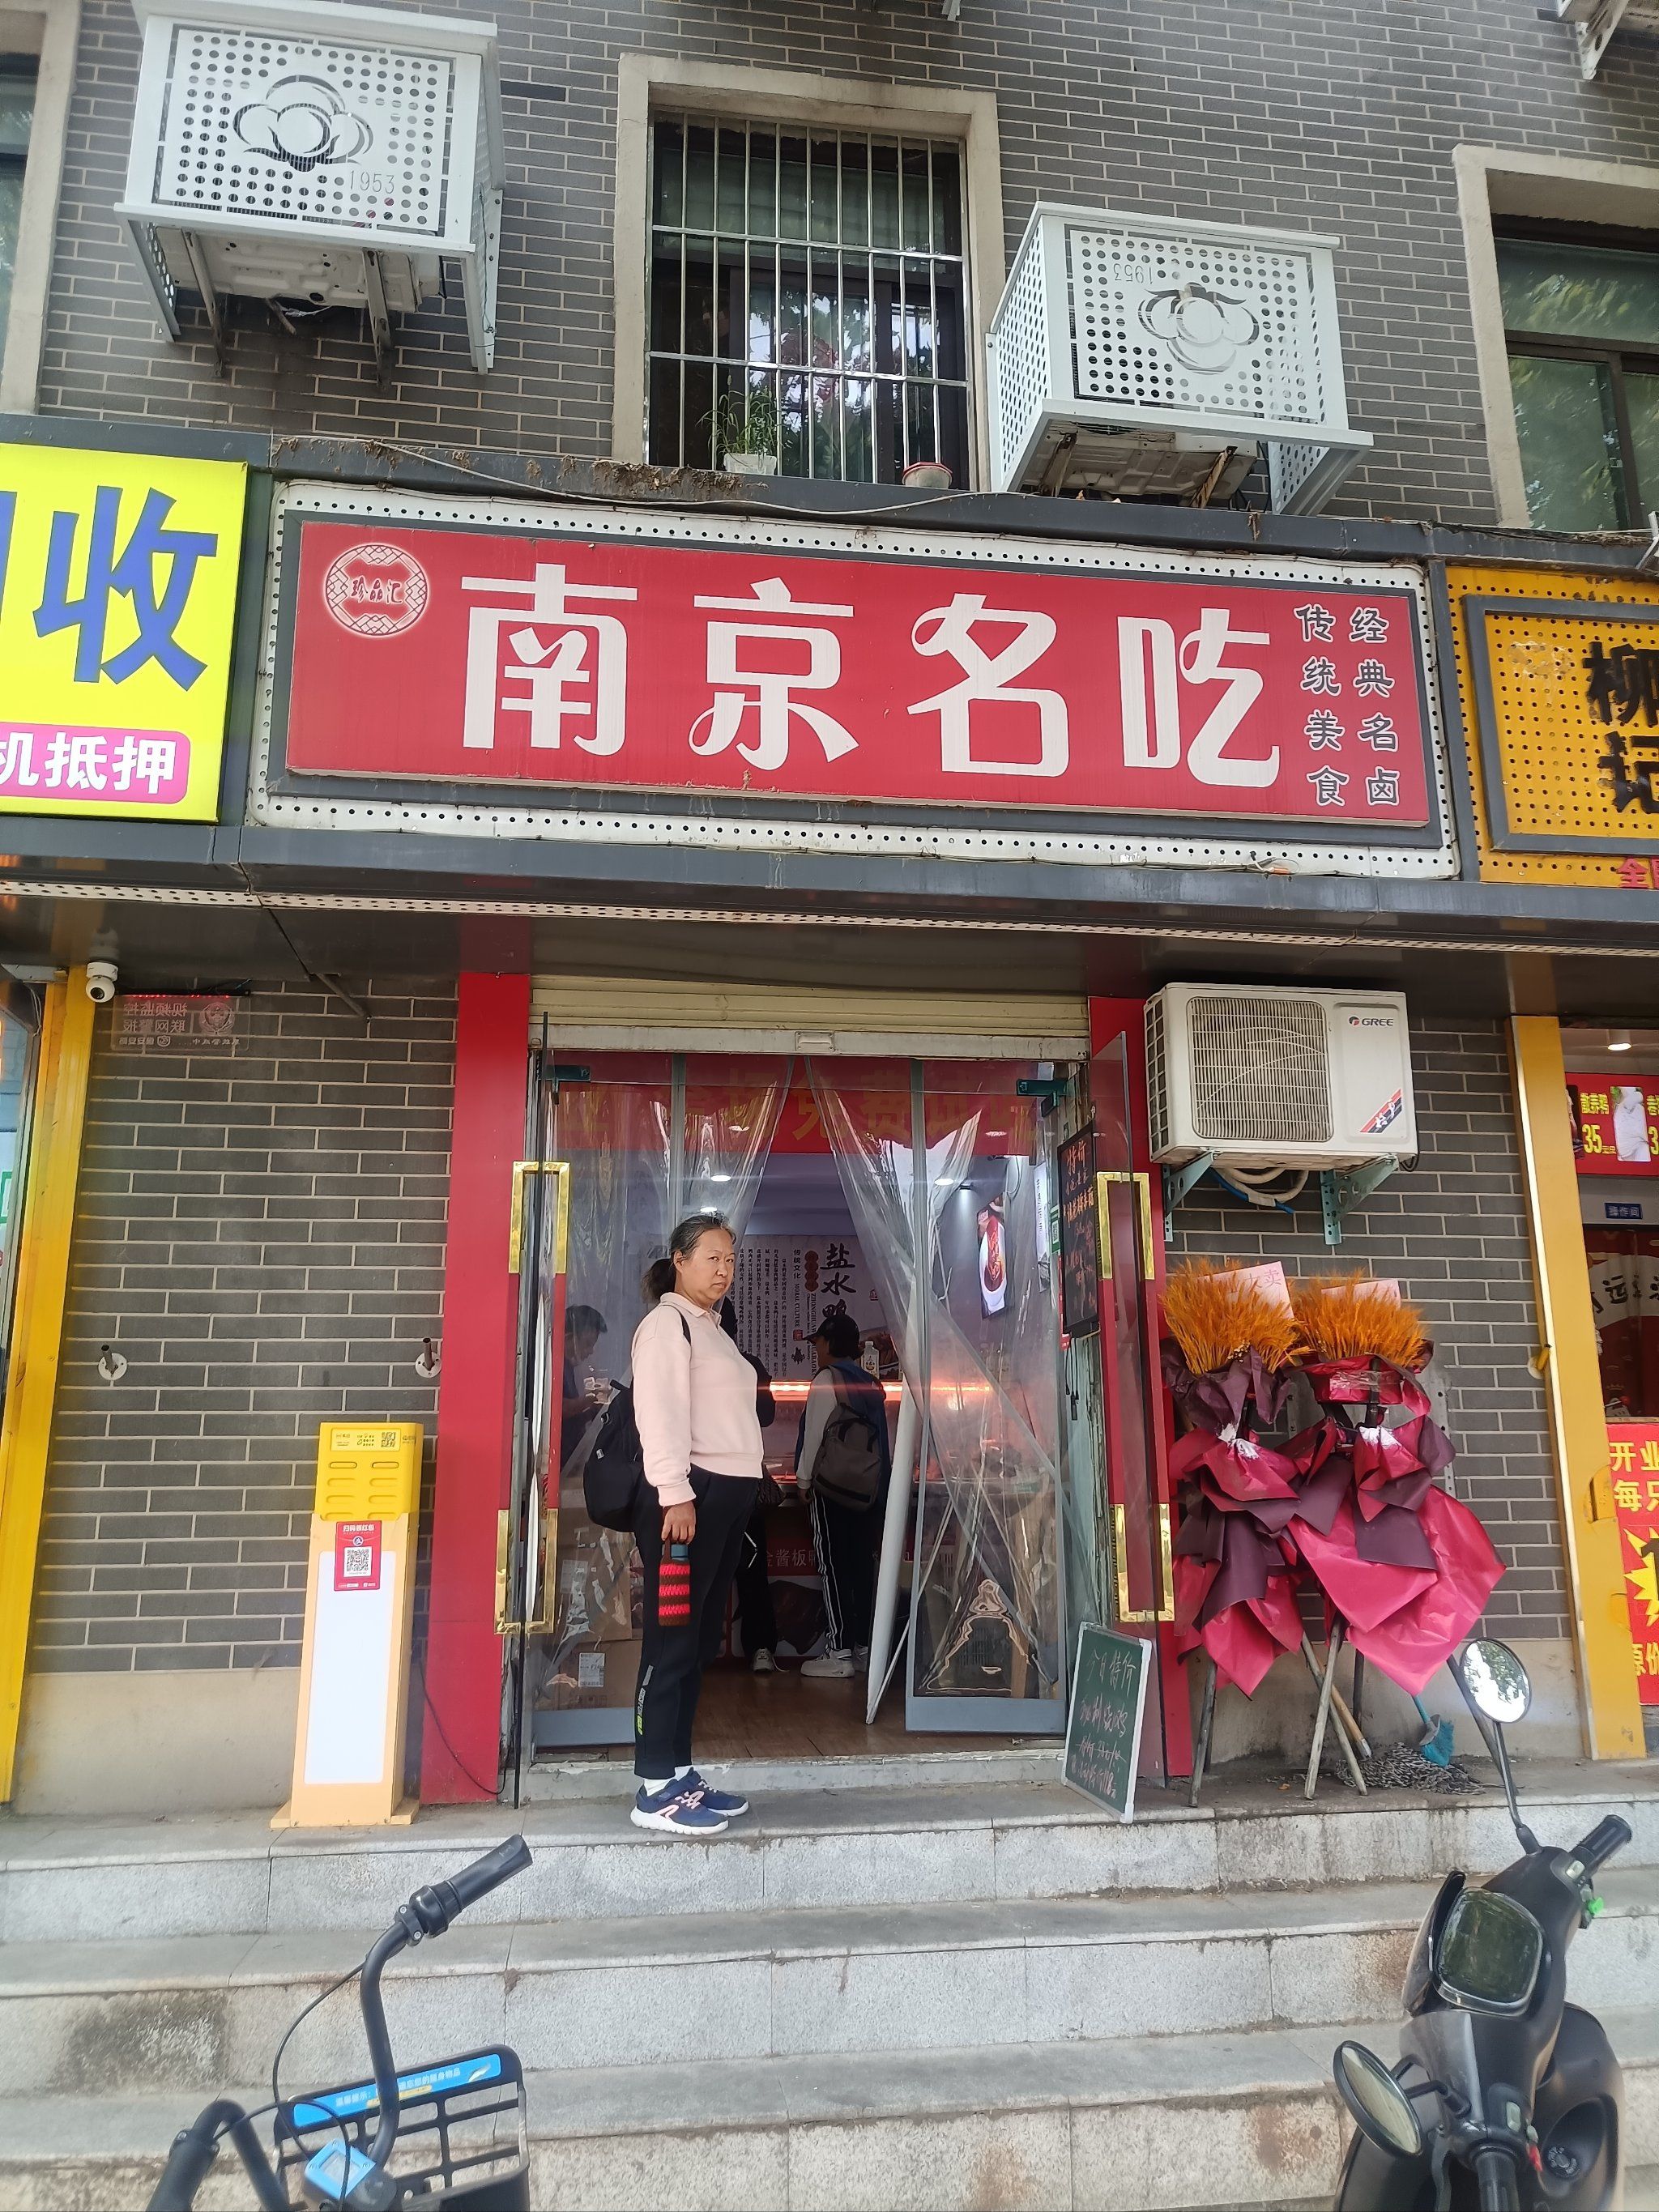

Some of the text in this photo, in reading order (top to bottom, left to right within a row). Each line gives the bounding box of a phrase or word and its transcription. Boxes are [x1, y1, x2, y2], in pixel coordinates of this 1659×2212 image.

[350, 170, 394, 194] 1953
[0, 484, 218, 691] 收
[351, 576, 402, 603] 珍品汇
[461, 563, 1280, 788] 南京名吃
[1294, 603, 1350, 806] 传统美食
[1349, 606, 1400, 806] 经典名卤
[1617, 856, 1659, 888] 全
[1361, 1017, 1394, 1026] GREE
